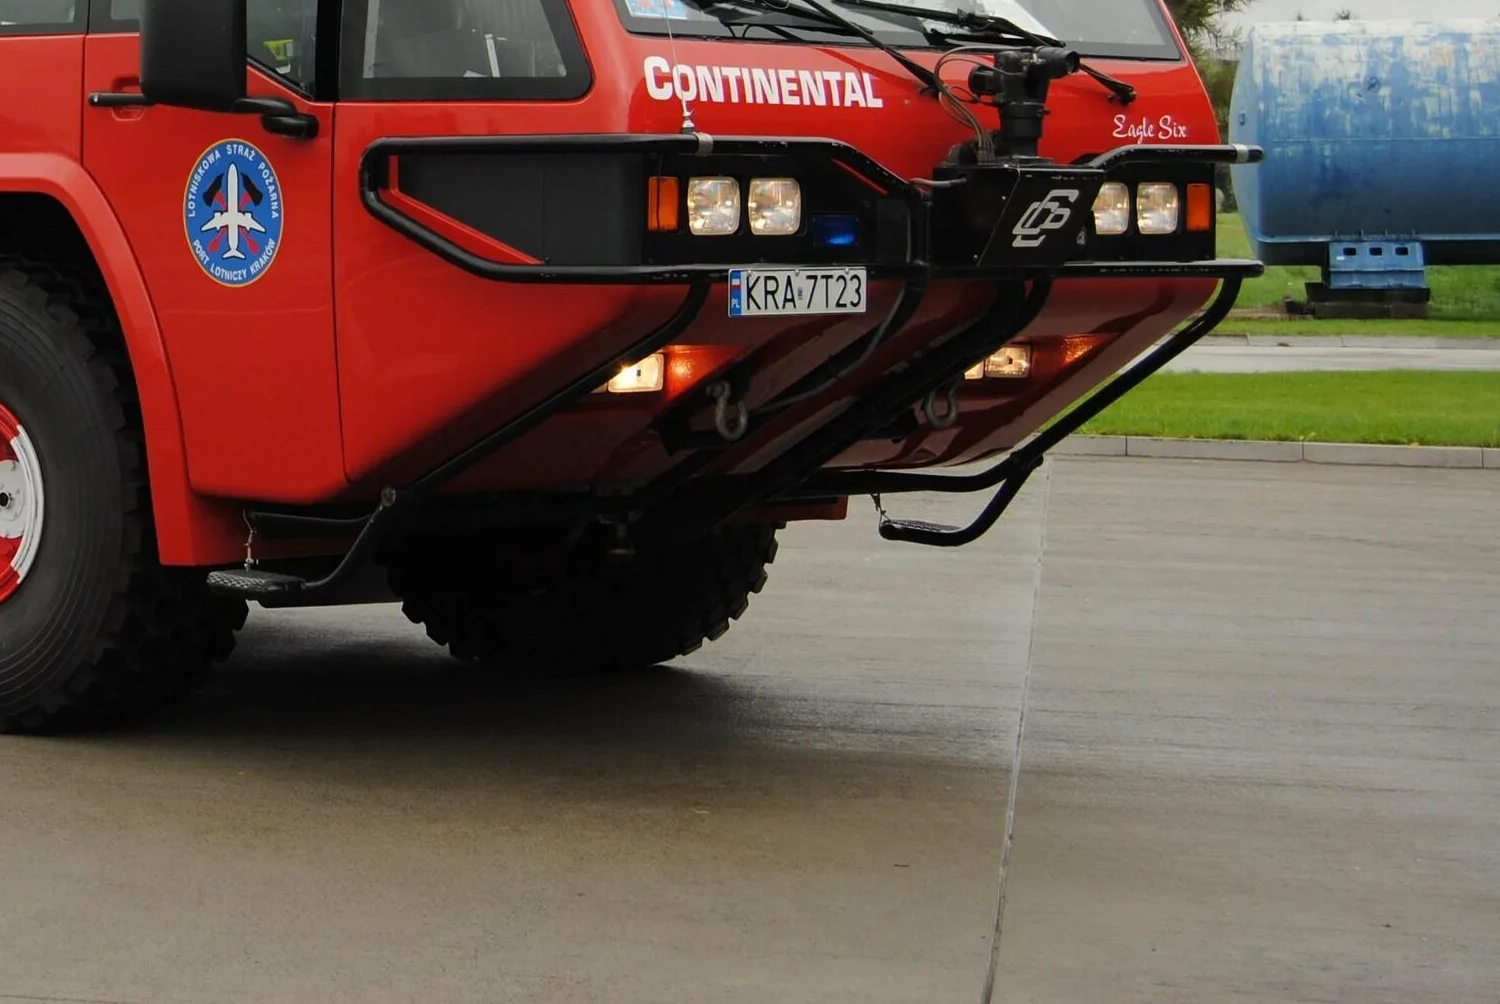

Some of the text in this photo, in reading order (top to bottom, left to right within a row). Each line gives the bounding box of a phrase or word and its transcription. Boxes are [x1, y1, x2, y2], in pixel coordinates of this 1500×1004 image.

[1112, 114, 1187, 144] Eagle Six
[188, 144, 279, 219] LOTNISKOWA STRAŻ POŻARNA
[192, 238, 276, 281] PORT LOTNICZY KRAKÓW
[731, 298, 740, 309] PL
[746, 274, 862, 310] KRA 7T23
